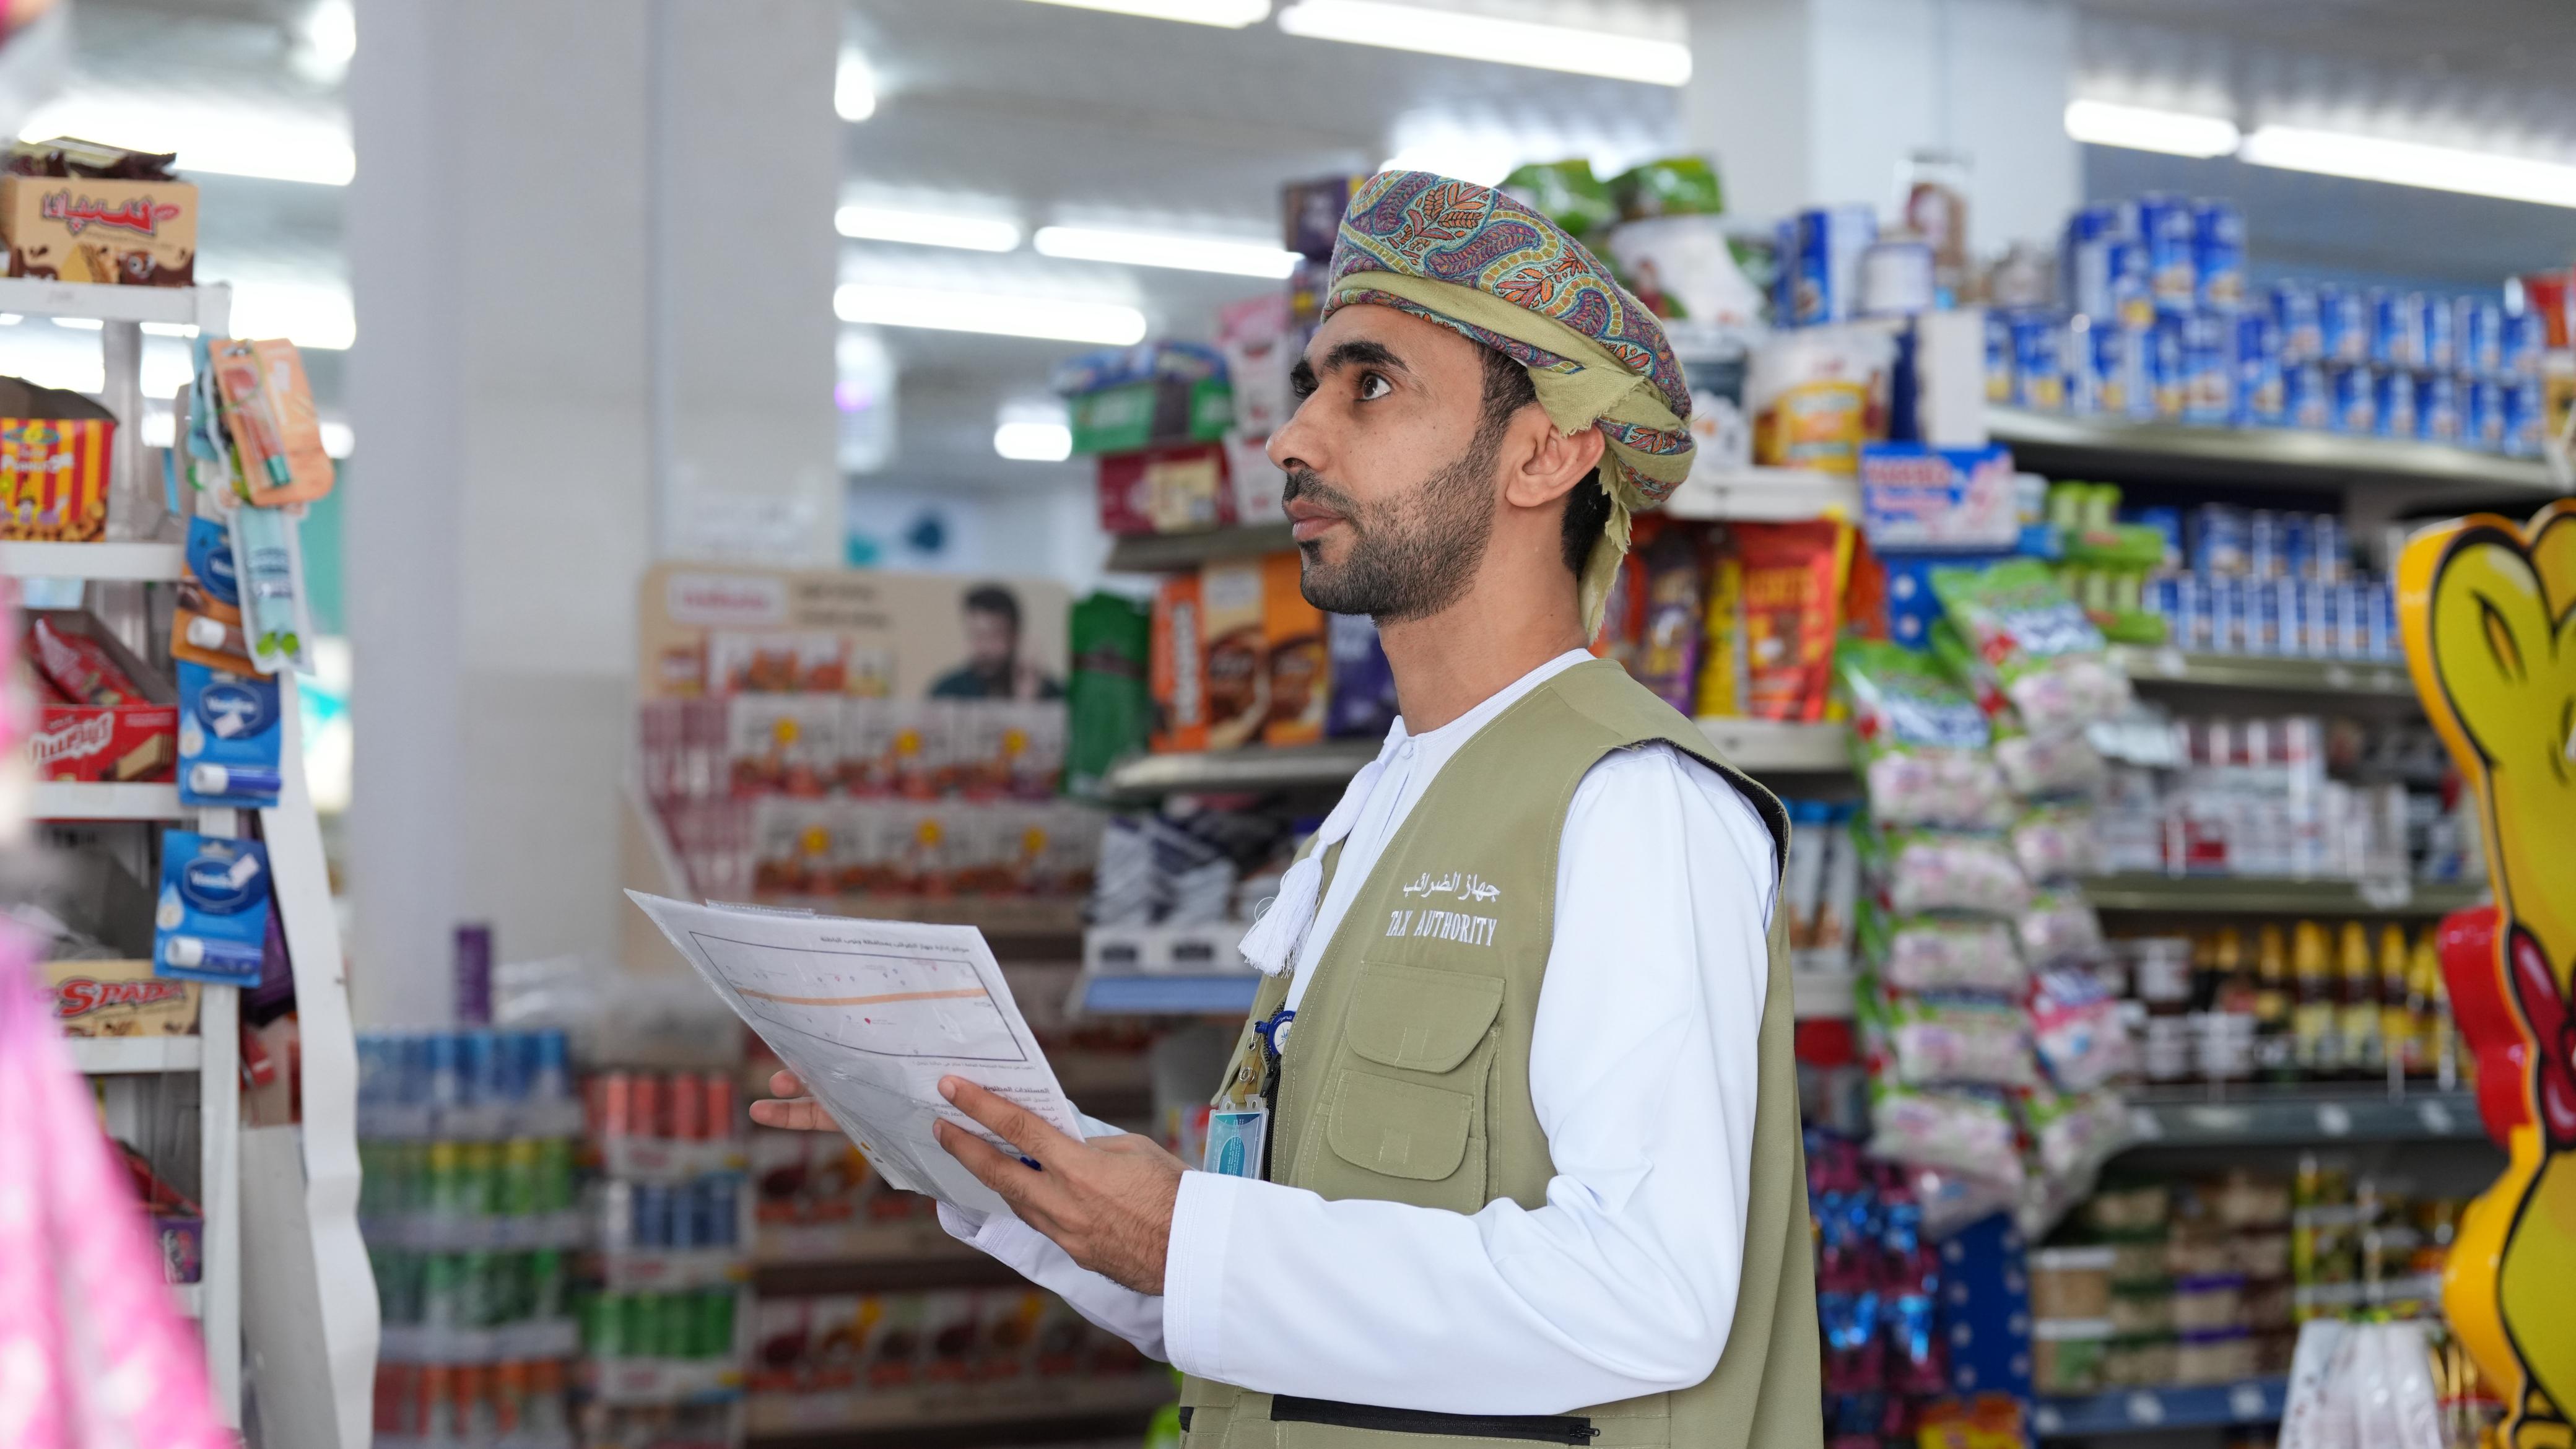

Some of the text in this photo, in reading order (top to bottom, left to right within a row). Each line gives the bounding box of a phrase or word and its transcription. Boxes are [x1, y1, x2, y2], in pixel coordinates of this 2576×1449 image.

[1403, 871, 1501, 902] جهاز الضرائب
[1386, 910, 1497, 947] TAX AUTHORITY
